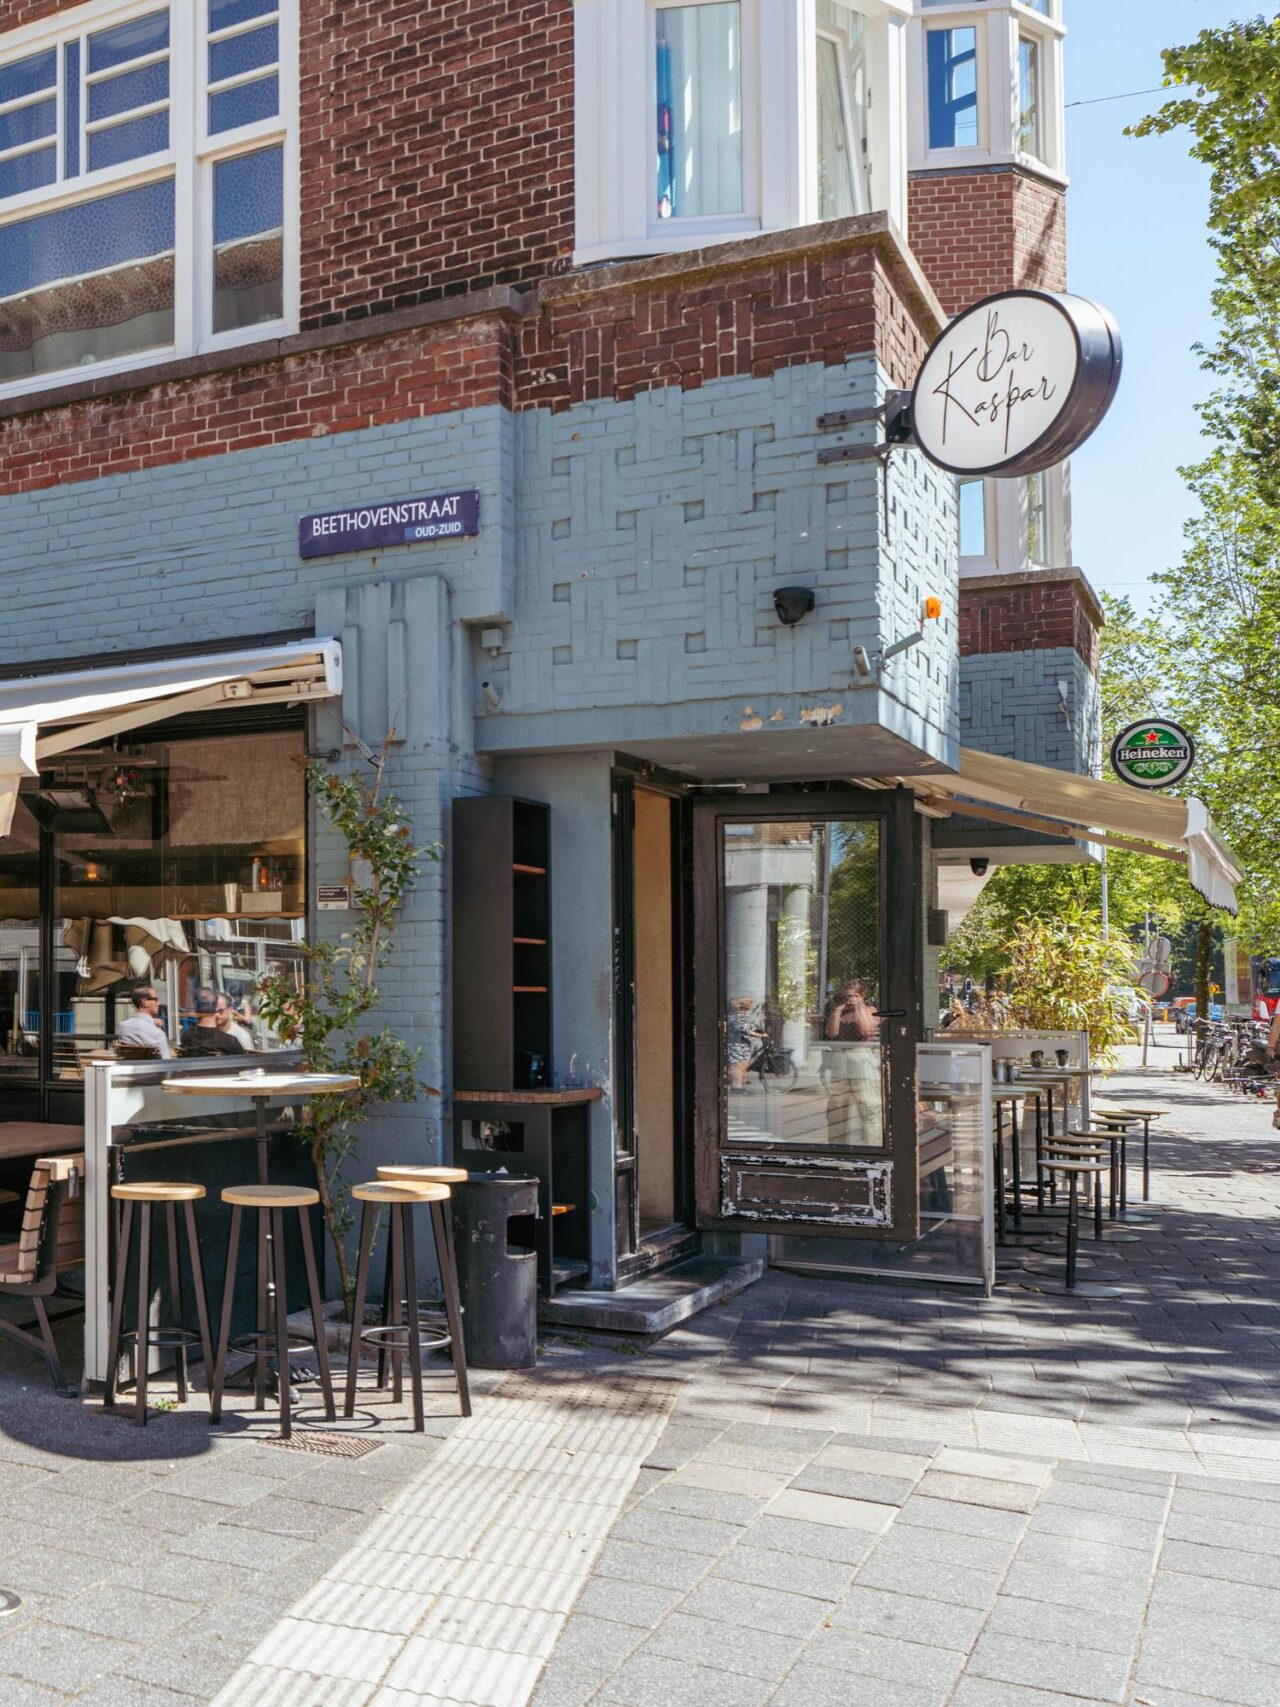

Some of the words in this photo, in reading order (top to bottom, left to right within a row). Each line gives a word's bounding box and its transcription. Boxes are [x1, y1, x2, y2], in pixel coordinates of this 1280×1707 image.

[976, 309, 1034, 382] Bar
[932, 347, 1056, 455] Kaspar
[312, 496, 461, 537] BEETHOVENSTRAAT
[415, 521, 462, 538] OUD-ZUID
[1120, 747, 1185, 760] Heineken
